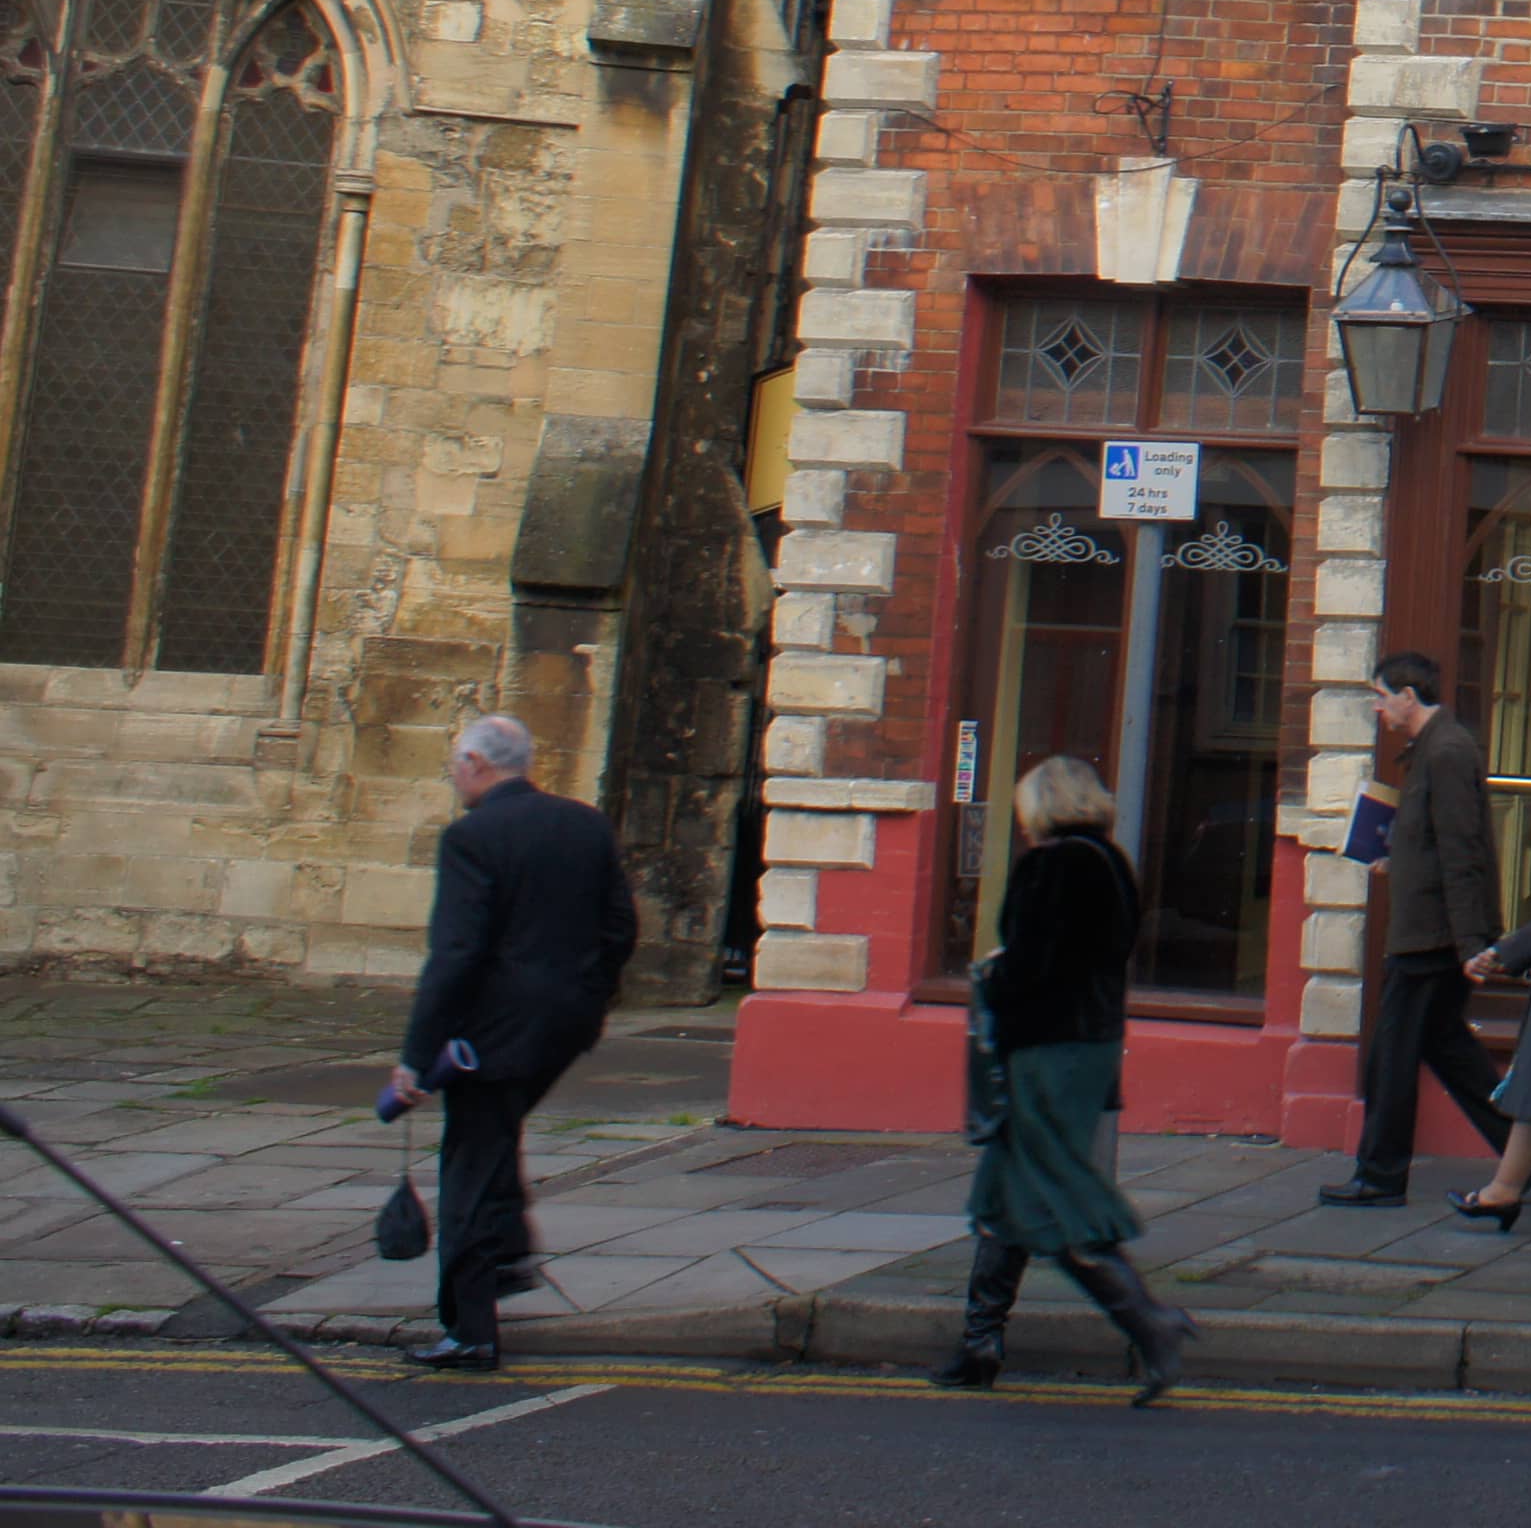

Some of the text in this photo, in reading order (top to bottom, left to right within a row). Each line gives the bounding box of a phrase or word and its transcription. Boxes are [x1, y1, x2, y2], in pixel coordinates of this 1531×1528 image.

[1144, 450, 1194, 465] Loading
[1154, 465, 1182, 479] only
[1128, 487, 1168, 499] 24 hrs
[1127, 501, 1168, 516] 7 days
